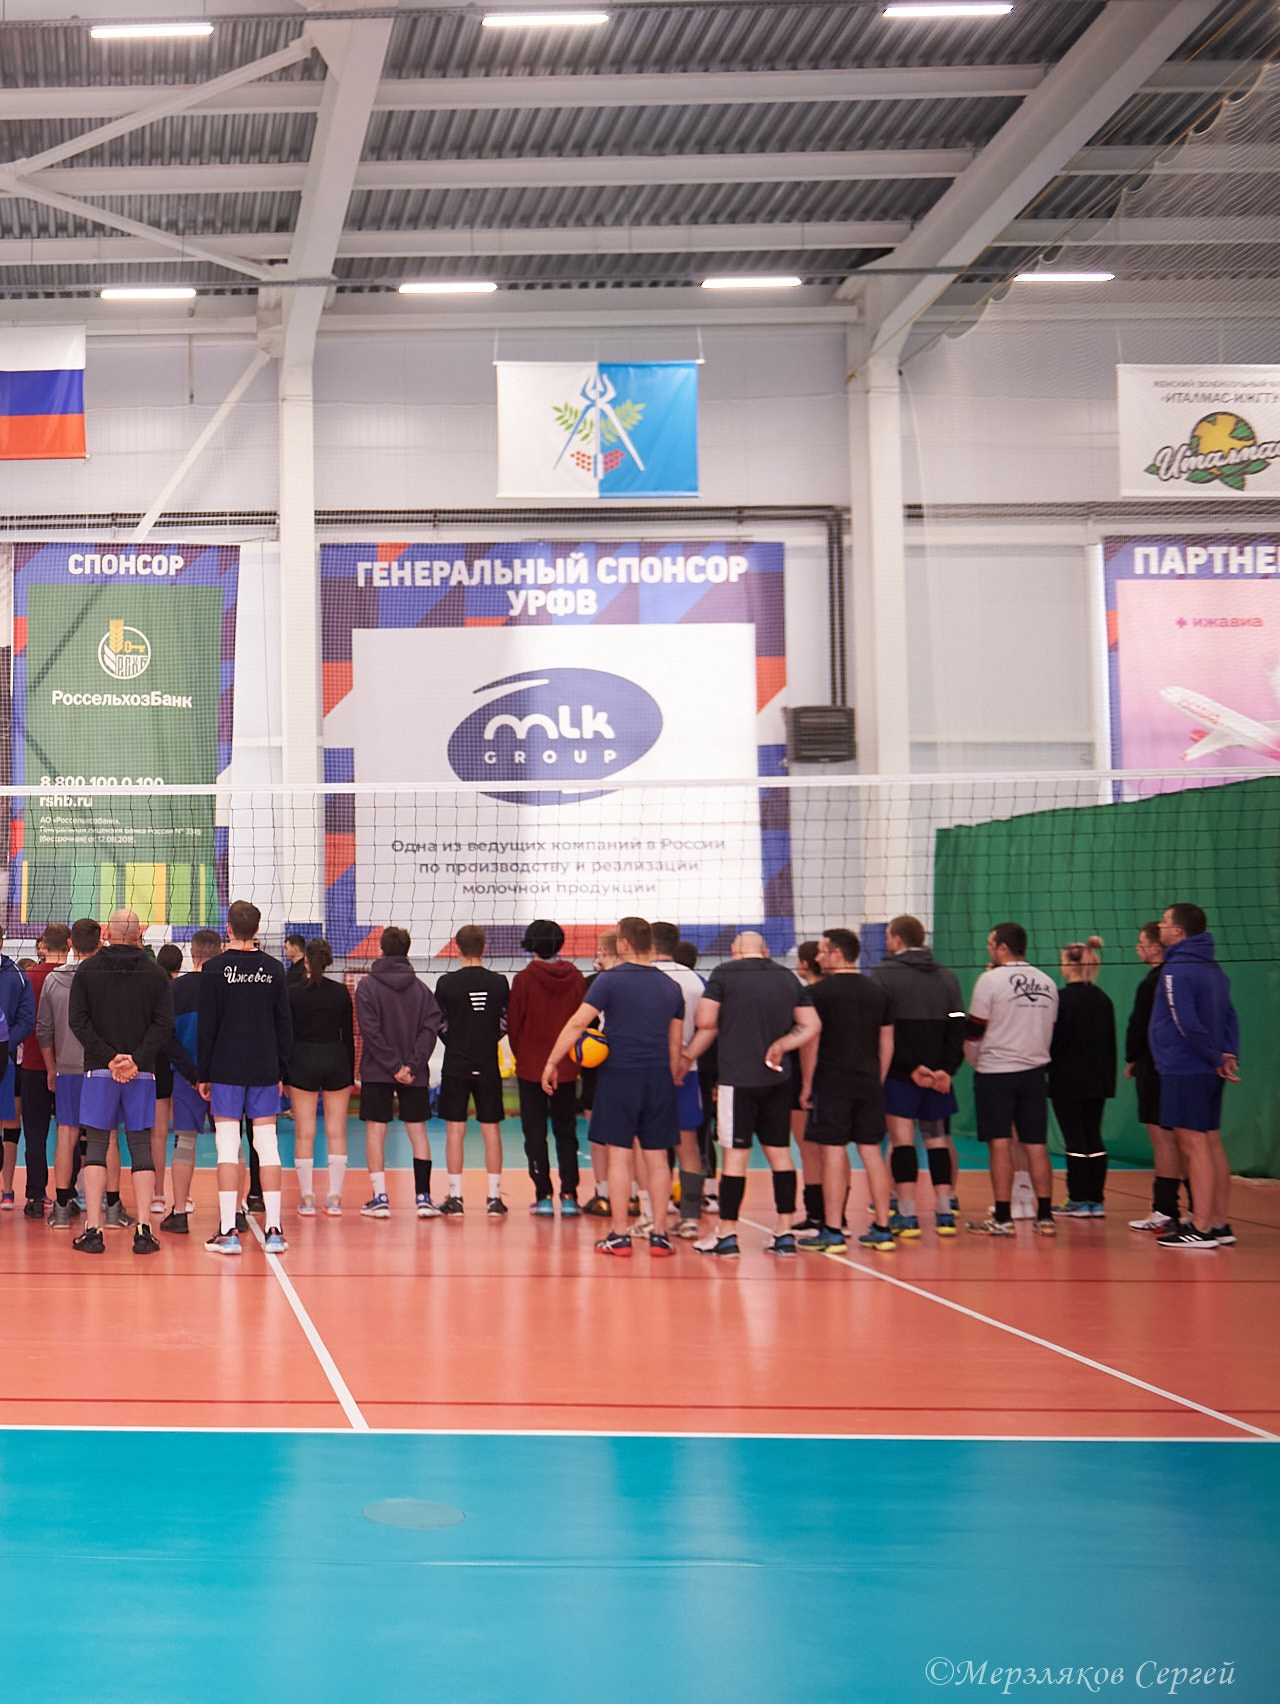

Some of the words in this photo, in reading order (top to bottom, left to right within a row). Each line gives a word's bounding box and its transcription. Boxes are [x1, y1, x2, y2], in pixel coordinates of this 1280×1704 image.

[1153, 440, 1280, 481] Италма
[67, 554, 185, 576] СПОНСОР
[1133, 546, 1280, 574] ПАРТНЕ
[356, 552, 589, 588] ГЕНЕРАЛЬНЫЙ
[597, 554, 748, 585] СПОНСОР
[507, 588, 598, 617] УРФВ
[1192, 617, 1264, 627] ижавиа
[51, 690, 193, 708] РоссельхозБанк
[484, 750, 617, 764] GROUP
[39, 795, 93, 808] rshb.ru
[391, 840, 438, 854] Одна
[442, 842, 461, 852] из
[468, 842, 546, 854] ведущих
[552, 838, 642, 851] компаний
[647, 840, 655, 850] в
[661, 838, 726, 851] России
[419, 863, 440, 874] по
[446, 862, 569, 876] производству
[592, 861, 699, 874] реализации
[462, 882, 550, 895] молочной
[556, 883, 656, 896] продукции
[223, 965, 273, 984] Ижевск
